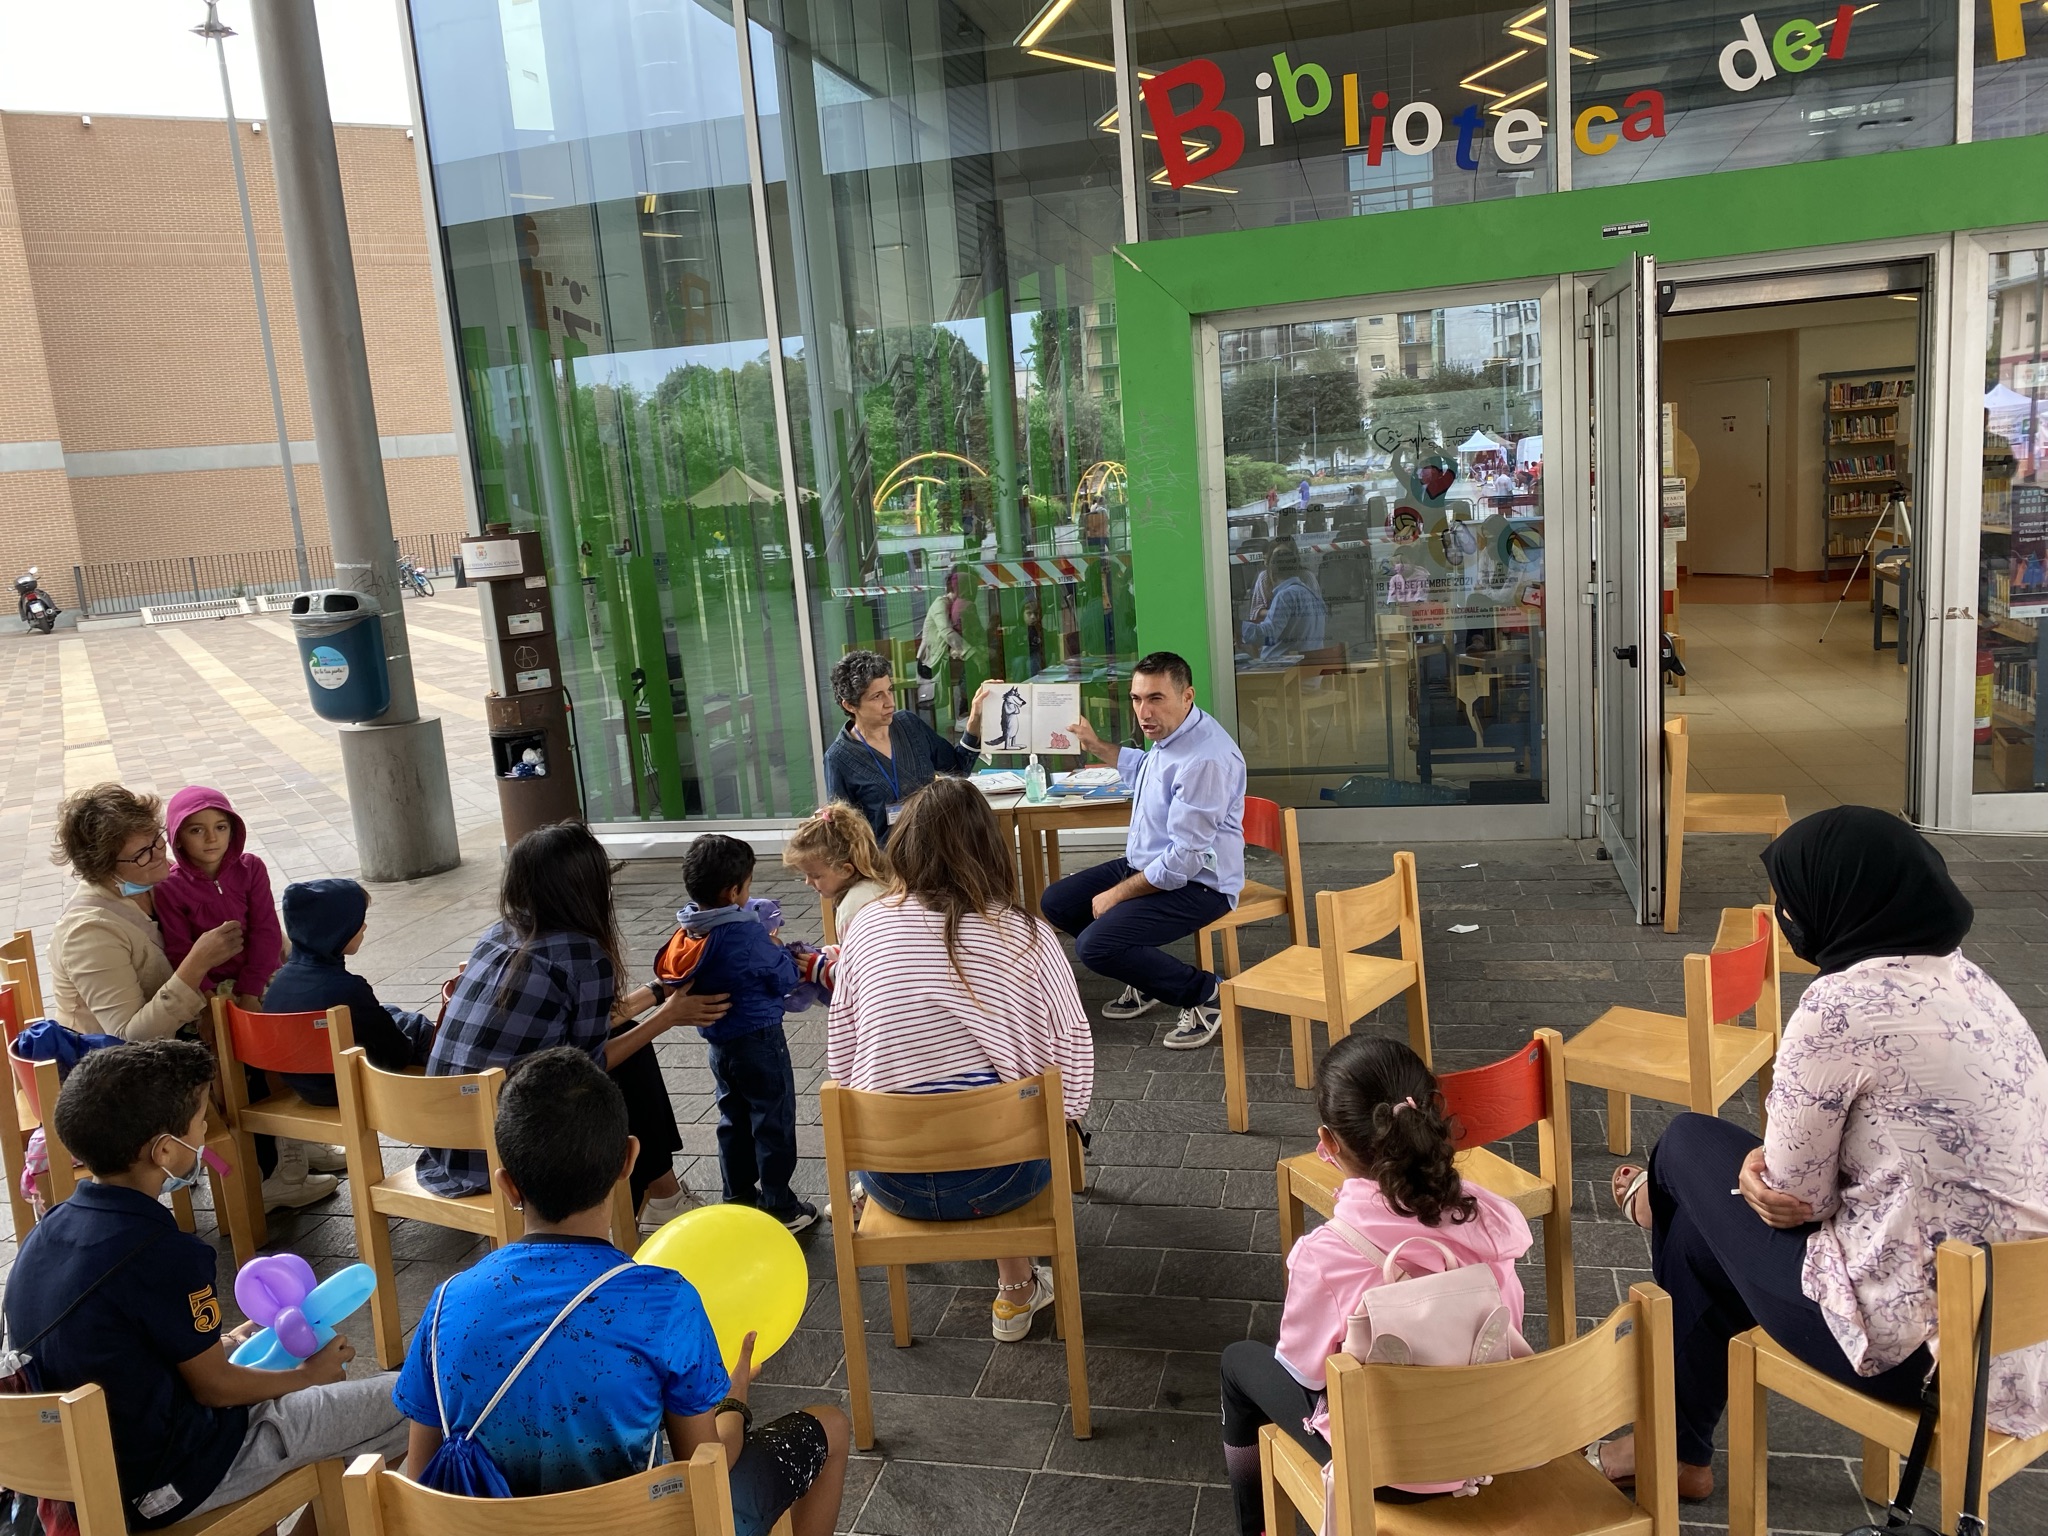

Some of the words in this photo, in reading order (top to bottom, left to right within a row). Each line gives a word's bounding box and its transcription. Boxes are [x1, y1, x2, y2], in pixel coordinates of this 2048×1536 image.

[1141, 52, 1667, 190] Biblioteca
[1376, 582, 1385, 591] 18
[1404, 578, 1451, 590] SETTEMBRE
[1454, 577, 1473, 586] 2021
[188, 1284, 221, 1332] 5
